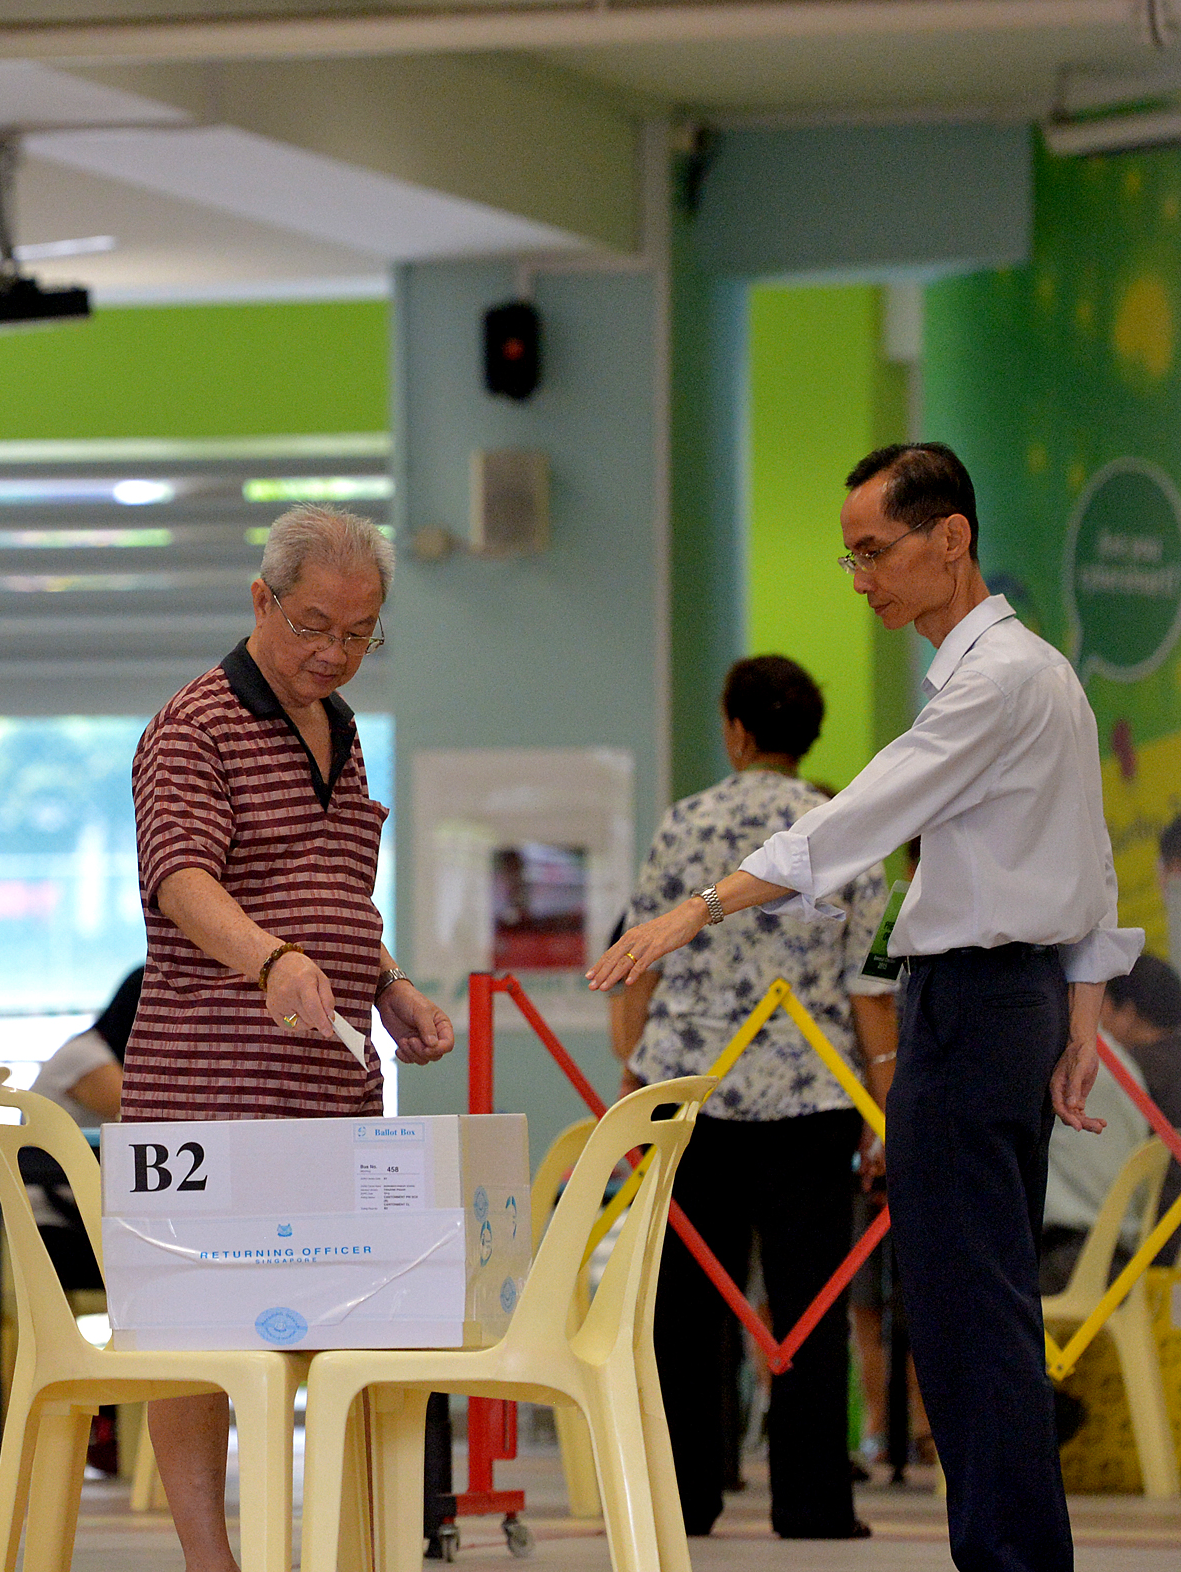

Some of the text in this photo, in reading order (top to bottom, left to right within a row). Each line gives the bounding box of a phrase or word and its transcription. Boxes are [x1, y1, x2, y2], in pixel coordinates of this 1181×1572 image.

[128, 1141, 209, 1193] B2
[200, 1246, 372, 1259] RETURNING OFFICER
